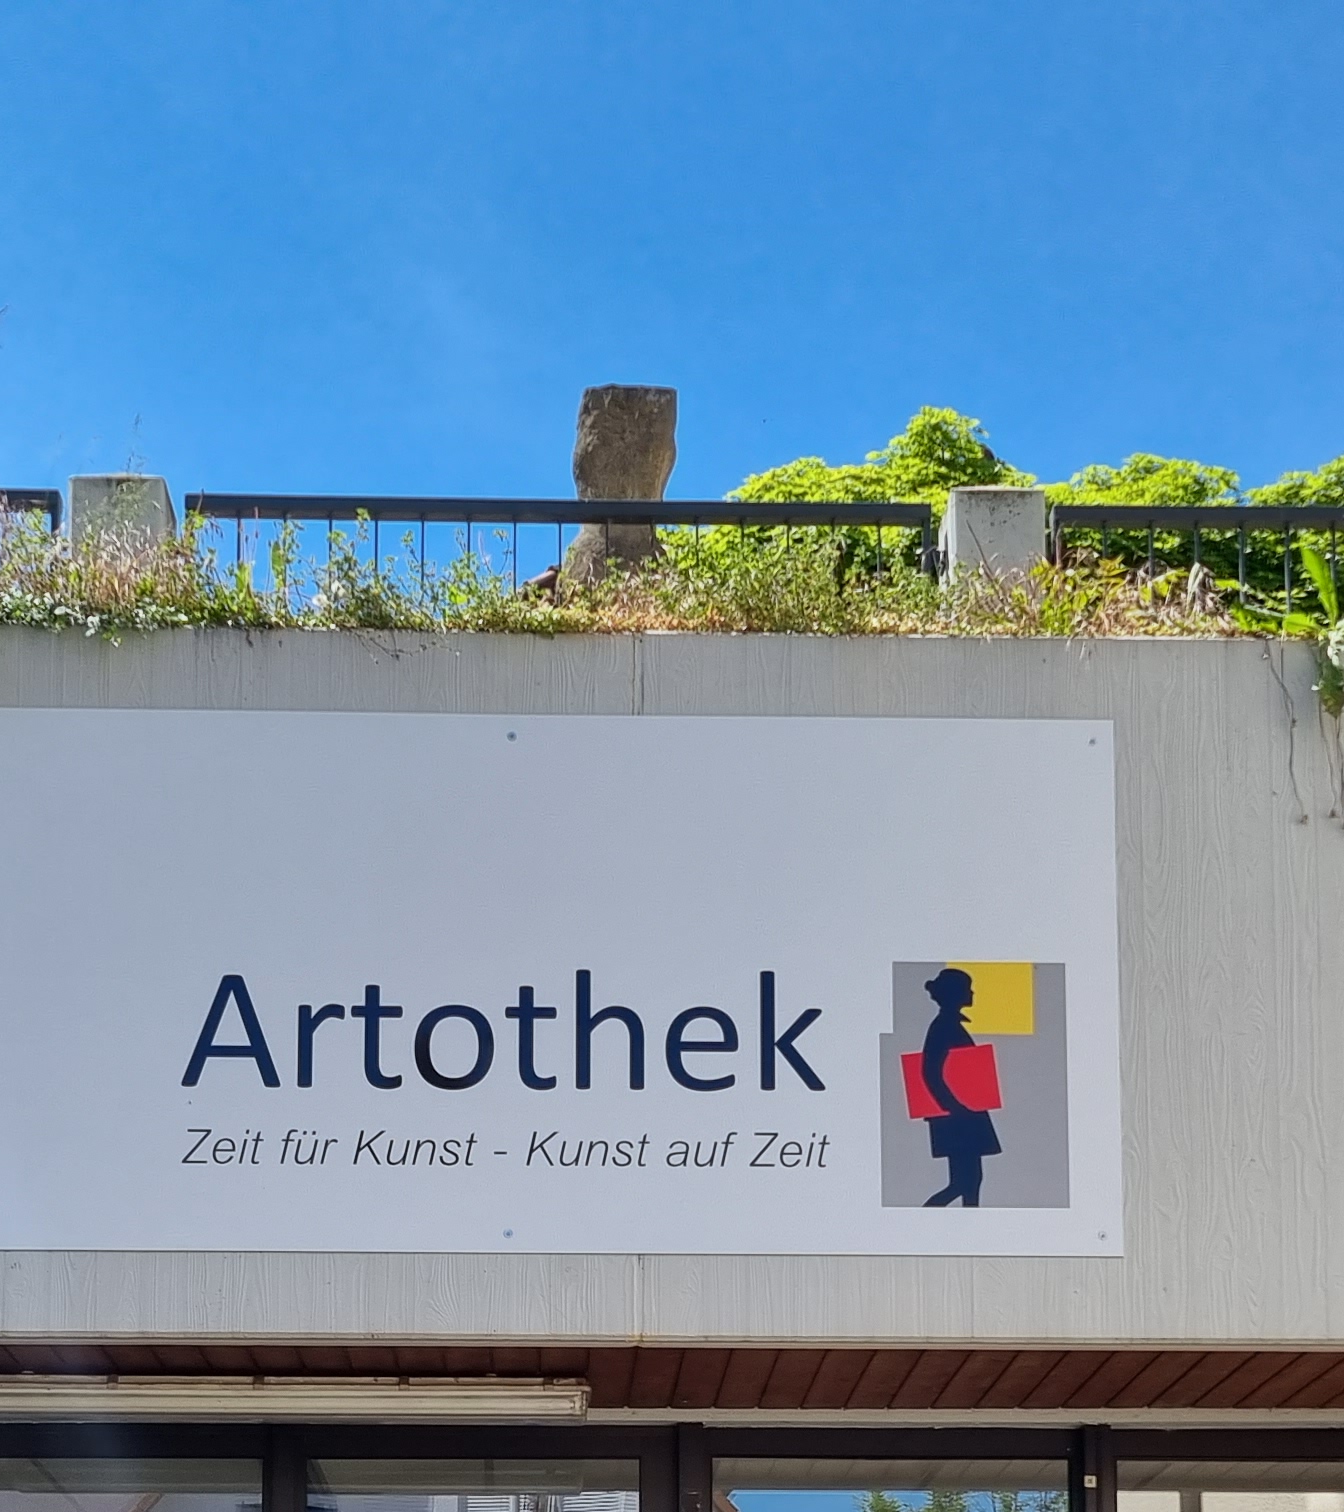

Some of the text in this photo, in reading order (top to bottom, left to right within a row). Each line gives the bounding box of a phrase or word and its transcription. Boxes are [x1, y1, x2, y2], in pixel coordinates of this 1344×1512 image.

[180, 968, 827, 1092] Artothek
[182, 1128, 263, 1165] Zeit
[279, 1129, 338, 1166] für
[352, 1130, 478, 1167] Kunst
[526, 1131, 651, 1168] Kunst
[665, 1130, 738, 1168] auf
[749, 1132, 831, 1168] Zeit
